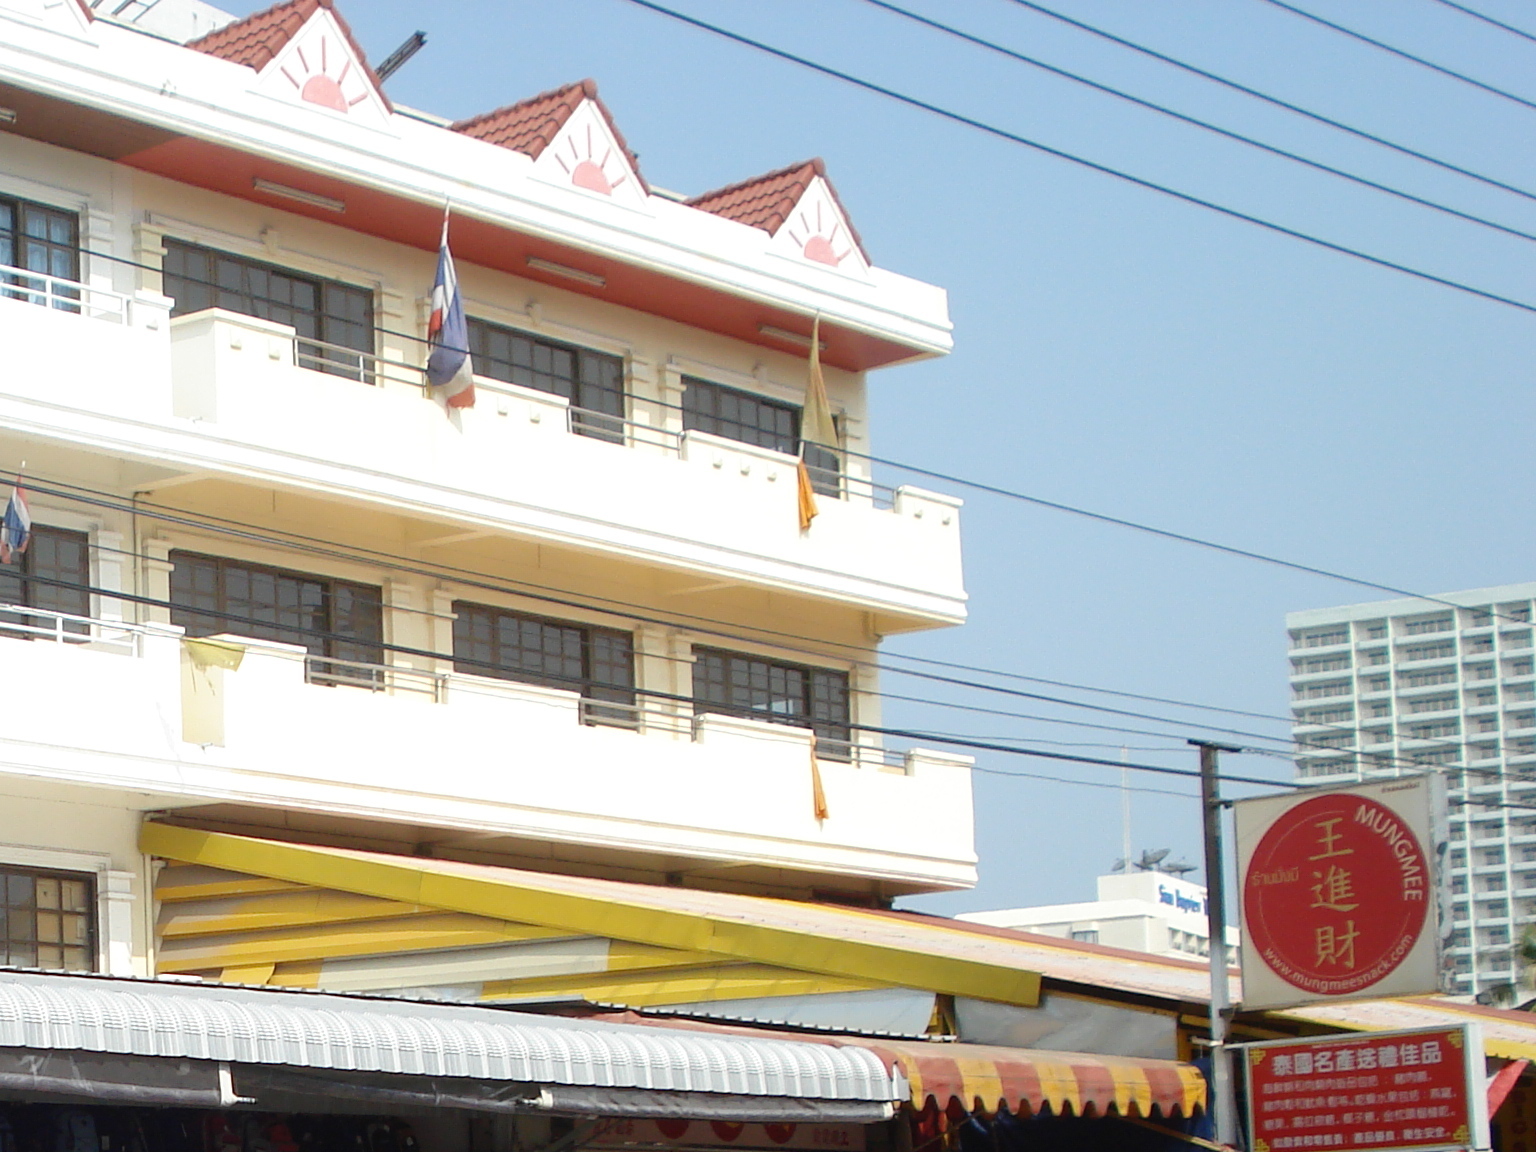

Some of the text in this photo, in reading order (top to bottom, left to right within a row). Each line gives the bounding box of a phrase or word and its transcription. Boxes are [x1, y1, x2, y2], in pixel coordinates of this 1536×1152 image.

[1309, 817, 1360, 968] 王進財
[1355, 804, 1423, 901] MUNGMEE
[1264, 934, 1412, 993] www.mungmeesnack.com
